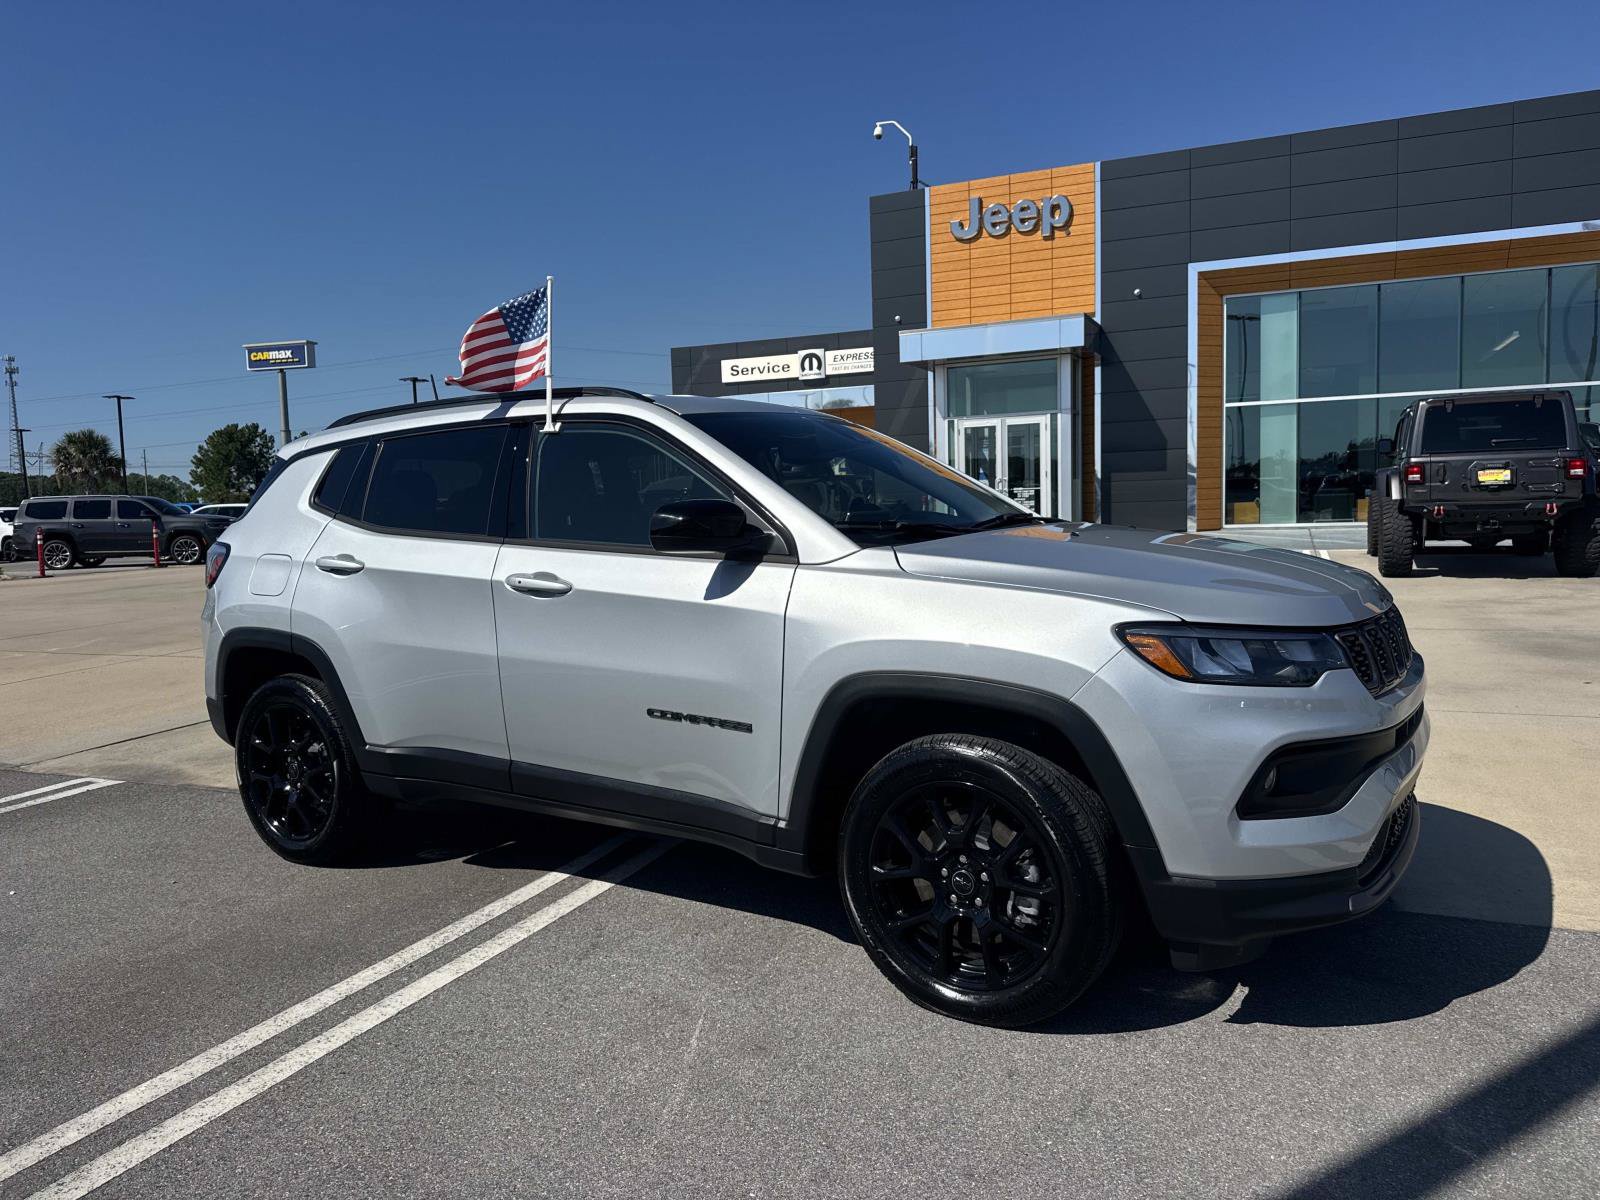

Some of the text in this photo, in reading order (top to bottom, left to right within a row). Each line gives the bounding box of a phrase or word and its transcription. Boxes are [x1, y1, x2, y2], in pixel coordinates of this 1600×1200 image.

[950, 193, 1072, 241] Jeep
[250, 350, 293, 361] CARmax
[833, 351, 875, 363] EXPRESS
[730, 362, 791, 377] Service
[646, 708, 753, 734] COMPASS
